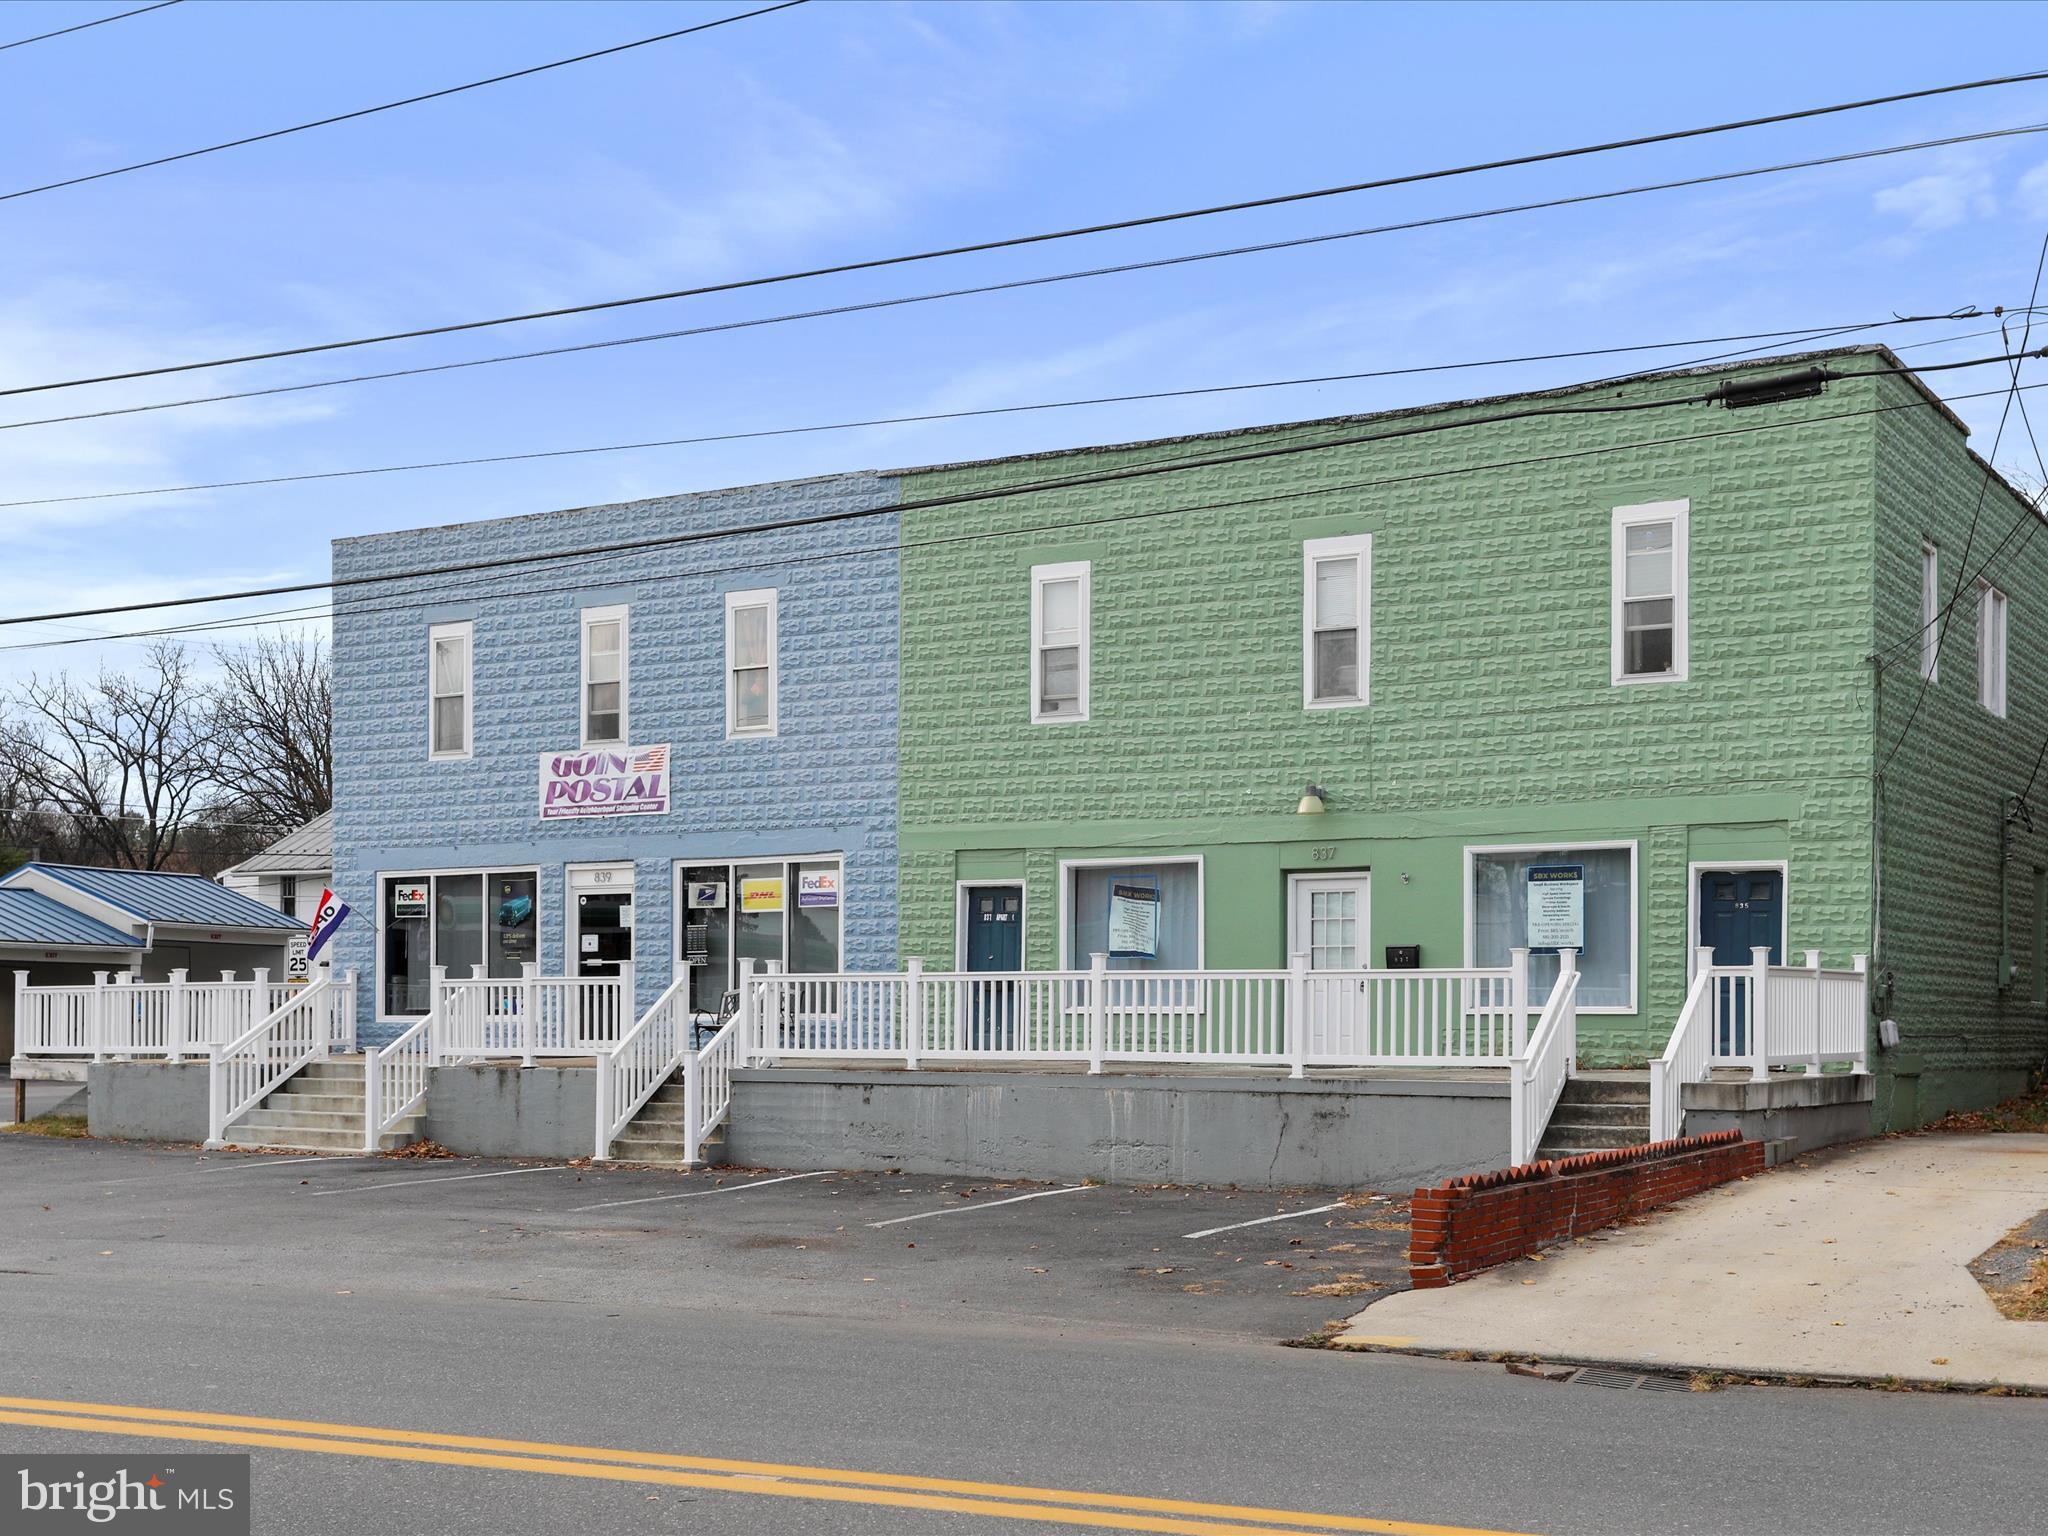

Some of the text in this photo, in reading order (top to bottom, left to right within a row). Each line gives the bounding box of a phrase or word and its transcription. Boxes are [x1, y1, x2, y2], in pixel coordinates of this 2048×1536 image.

[545, 774, 666, 804] POSTAL
[639, 803, 658, 811] Center
[1311, 846, 1336, 860] 837
[594, 871, 611, 883] 839
[1550, 871, 1578, 879] WORKS
[802, 876, 834, 889] FedEx
[398, 889, 424, 901] FedEx
[750, 891, 775, 900] DHL
[289, 957, 307, 972] 25
